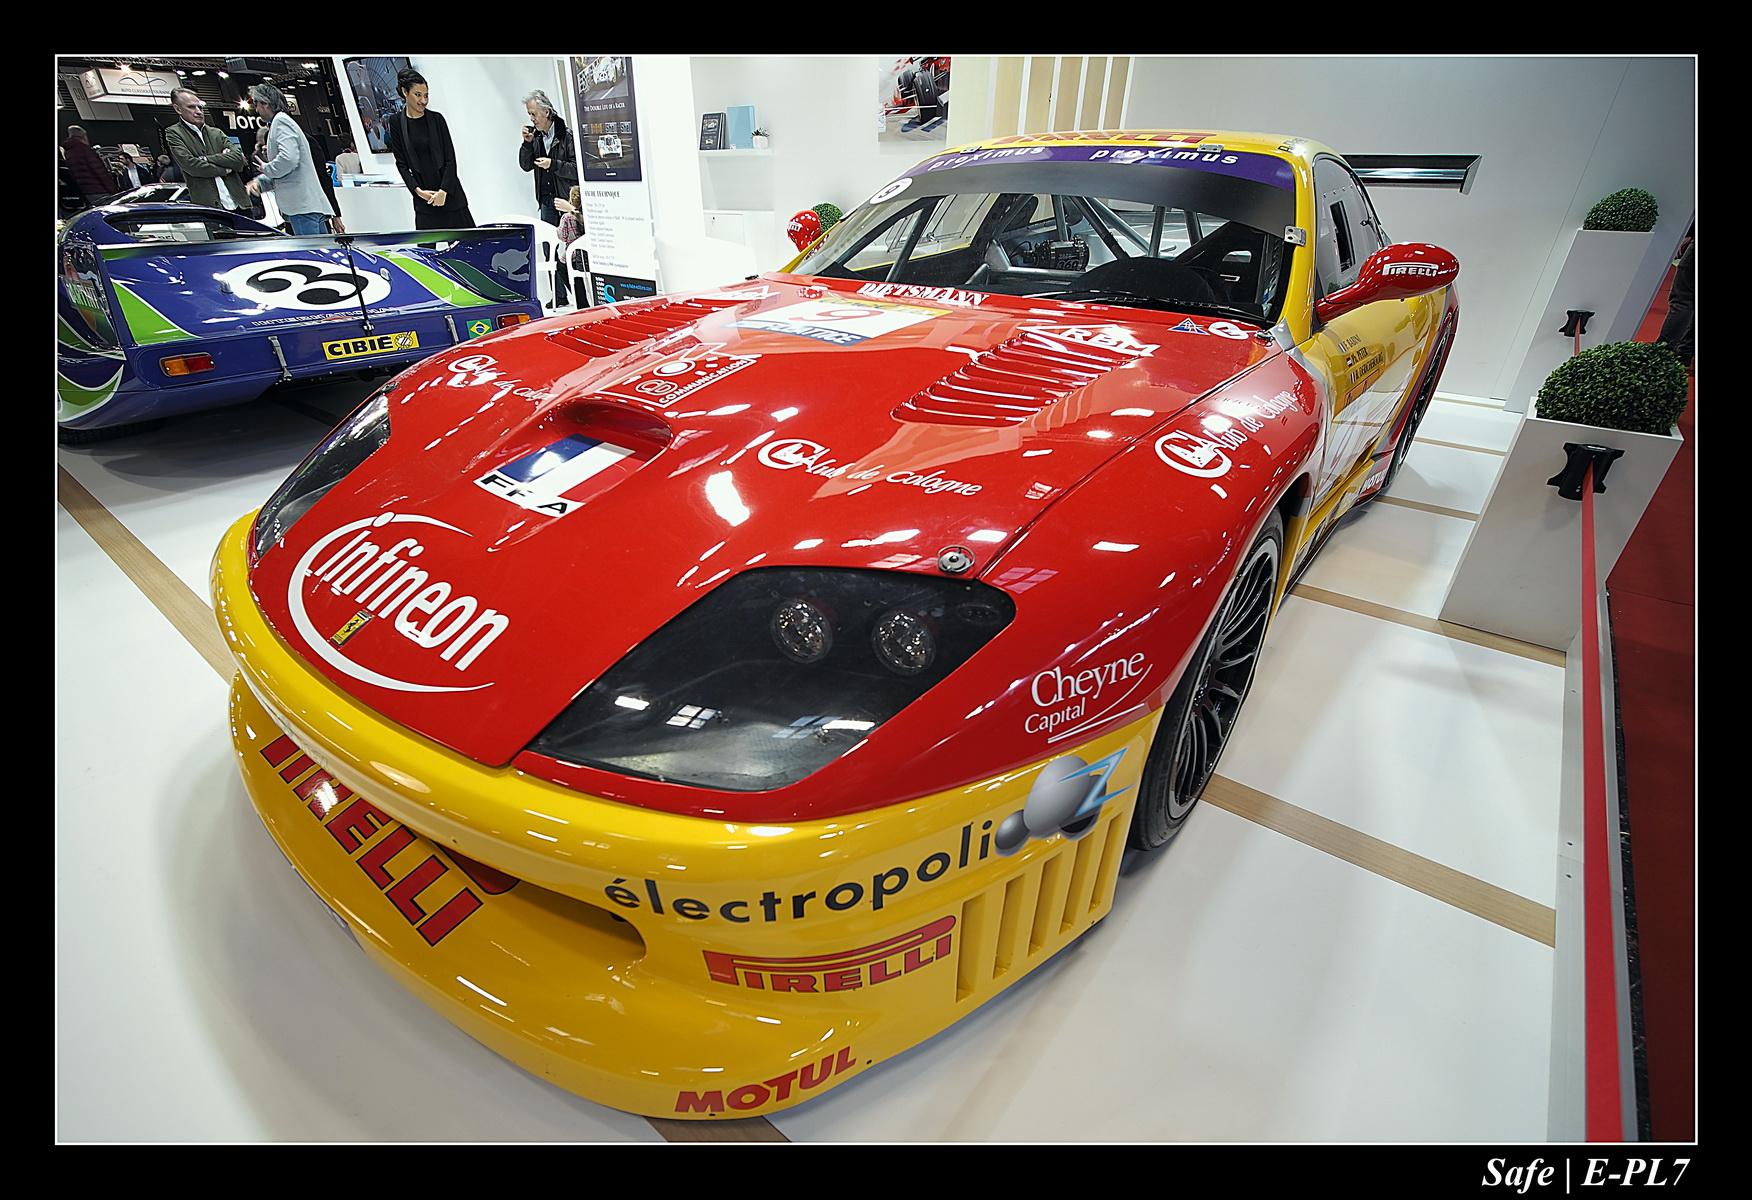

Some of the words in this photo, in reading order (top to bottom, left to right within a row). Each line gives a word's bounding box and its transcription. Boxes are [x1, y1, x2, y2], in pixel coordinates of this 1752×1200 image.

[926, 146, 1046, 172] proximus
[1089, 147, 1240, 164] proximus
[246, 264, 369, 305] 3
[1382, 261, 1439, 277] PIRELLI
[856, 283, 989, 306] DIETSMANN
[789, 308, 885, 322] 9
[658, 359, 750, 405] COMMUNICATION
[885, 470, 983, 496] Cologne
[1031, 652, 1145, 707] Cheyne
[1024, 696, 1086, 734] Capital
[603, 819, 993, 924] électropoli
[702, 915, 957, 994] PIRELLI
[674, 1046, 857, 1113] MOTUL
